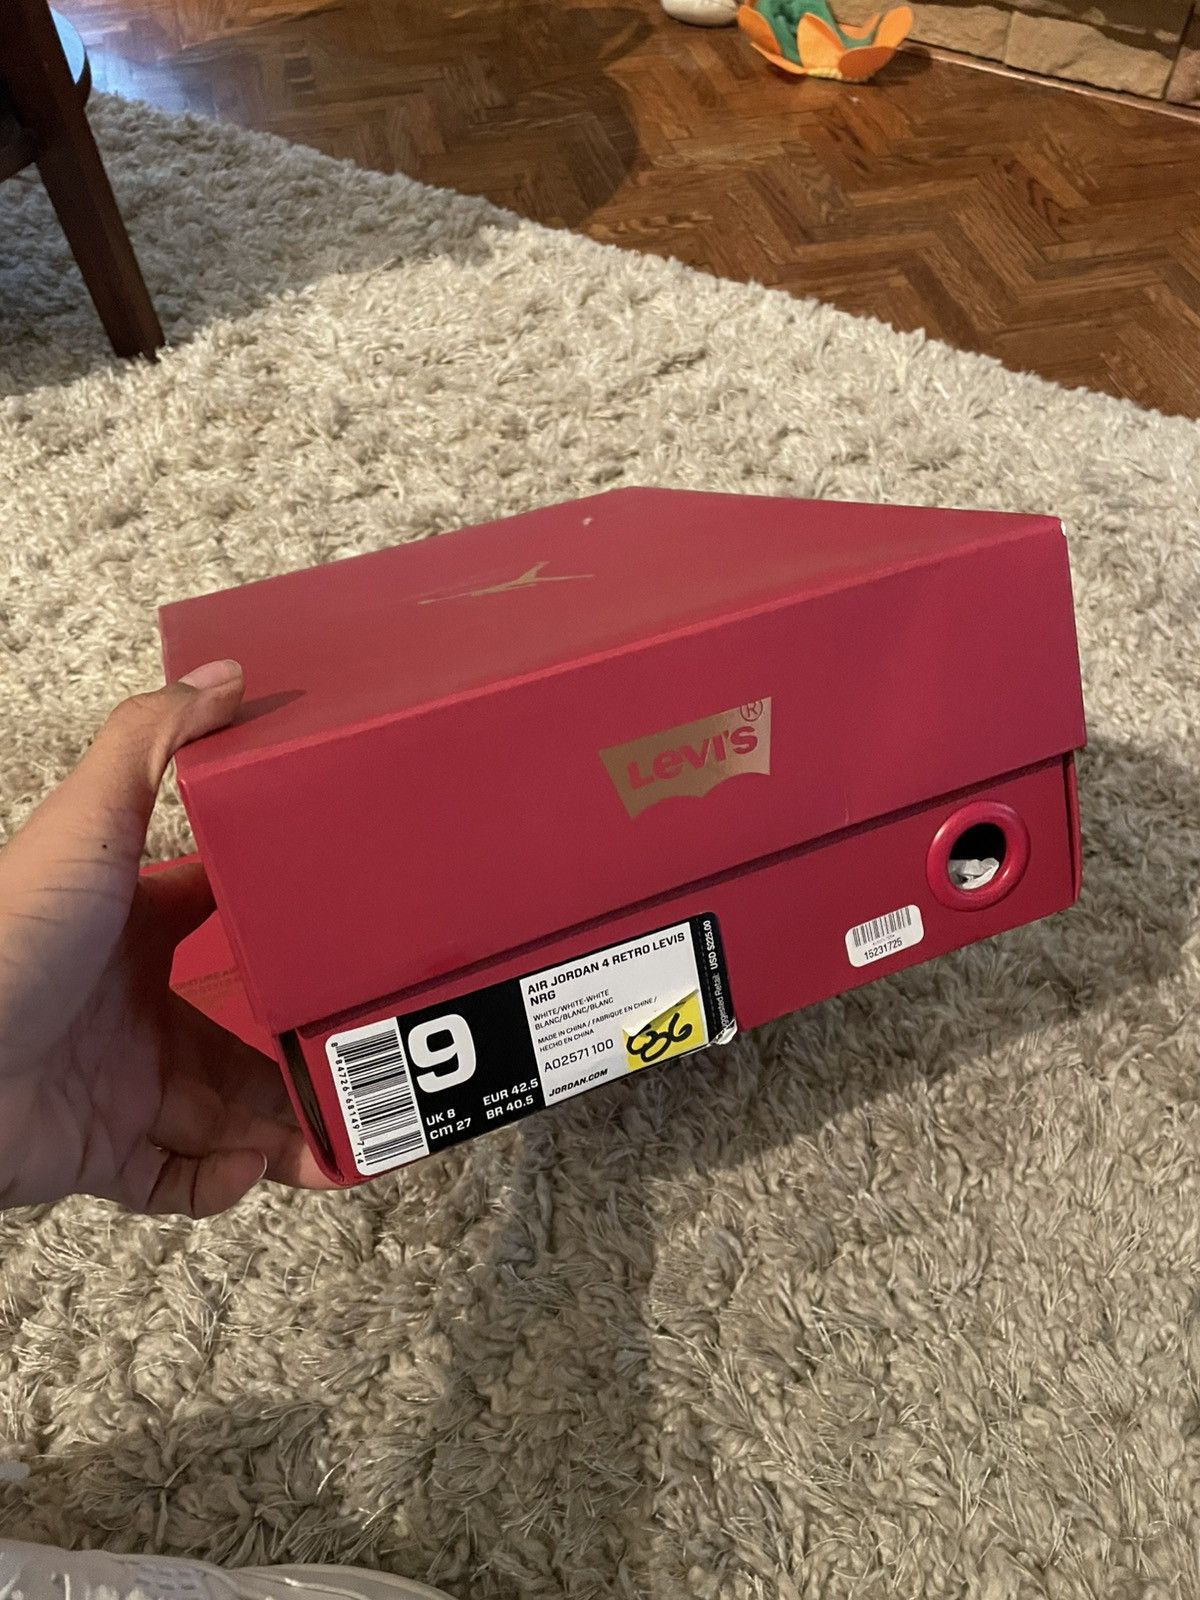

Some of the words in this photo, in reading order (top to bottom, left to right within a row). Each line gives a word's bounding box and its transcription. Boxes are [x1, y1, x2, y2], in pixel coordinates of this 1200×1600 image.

[703, 920, 715, 952] $225.00
[864, 937, 902, 960] 15231725
[528, 980, 548, 995] AIR
[551, 961, 600, 987] JORDAN
[602, 959, 610, 968] 4
[612, 944, 650, 965] RETRO
[652, 932, 685, 951] LEVIS
[708, 952, 718, 970] USD
[530, 990, 556, 1007] NRG
[533, 989, 610, 1022] WHITE/WHITE-WHITE
[535, 997, 614, 1031] BLANC/BLANC/BLANC
[538, 1032, 558, 1044] MADE
[566, 1022, 587, 1034] CHINA
[592, 1008, 623, 1025] FABRIQUE
[624, 1004, 633, 1012] EN
[634, 998, 652, 1008] CHINE
[408, 1014, 477, 1094] 9
[540, 1040, 563, 1052] HECHO
[564, 1036, 573, 1044] EN
[574, 1028, 594, 1040] CHINA
[335, 1060, 350, 1092] 84726
[346, 1098, 360, 1130] 68149
[482, 1088, 509, 1106] EUR
[511, 1078, 539, 1096] 42.5
[548, 1068, 608, 1097] JORDAN.COM
[426, 1113, 444, 1126] UK
[447, 1108, 456, 1119] 8
[486, 1106, 504, 1120] BR
[506, 1096, 534, 1112] 40.5
[456, 1118, 472, 1131] 27
